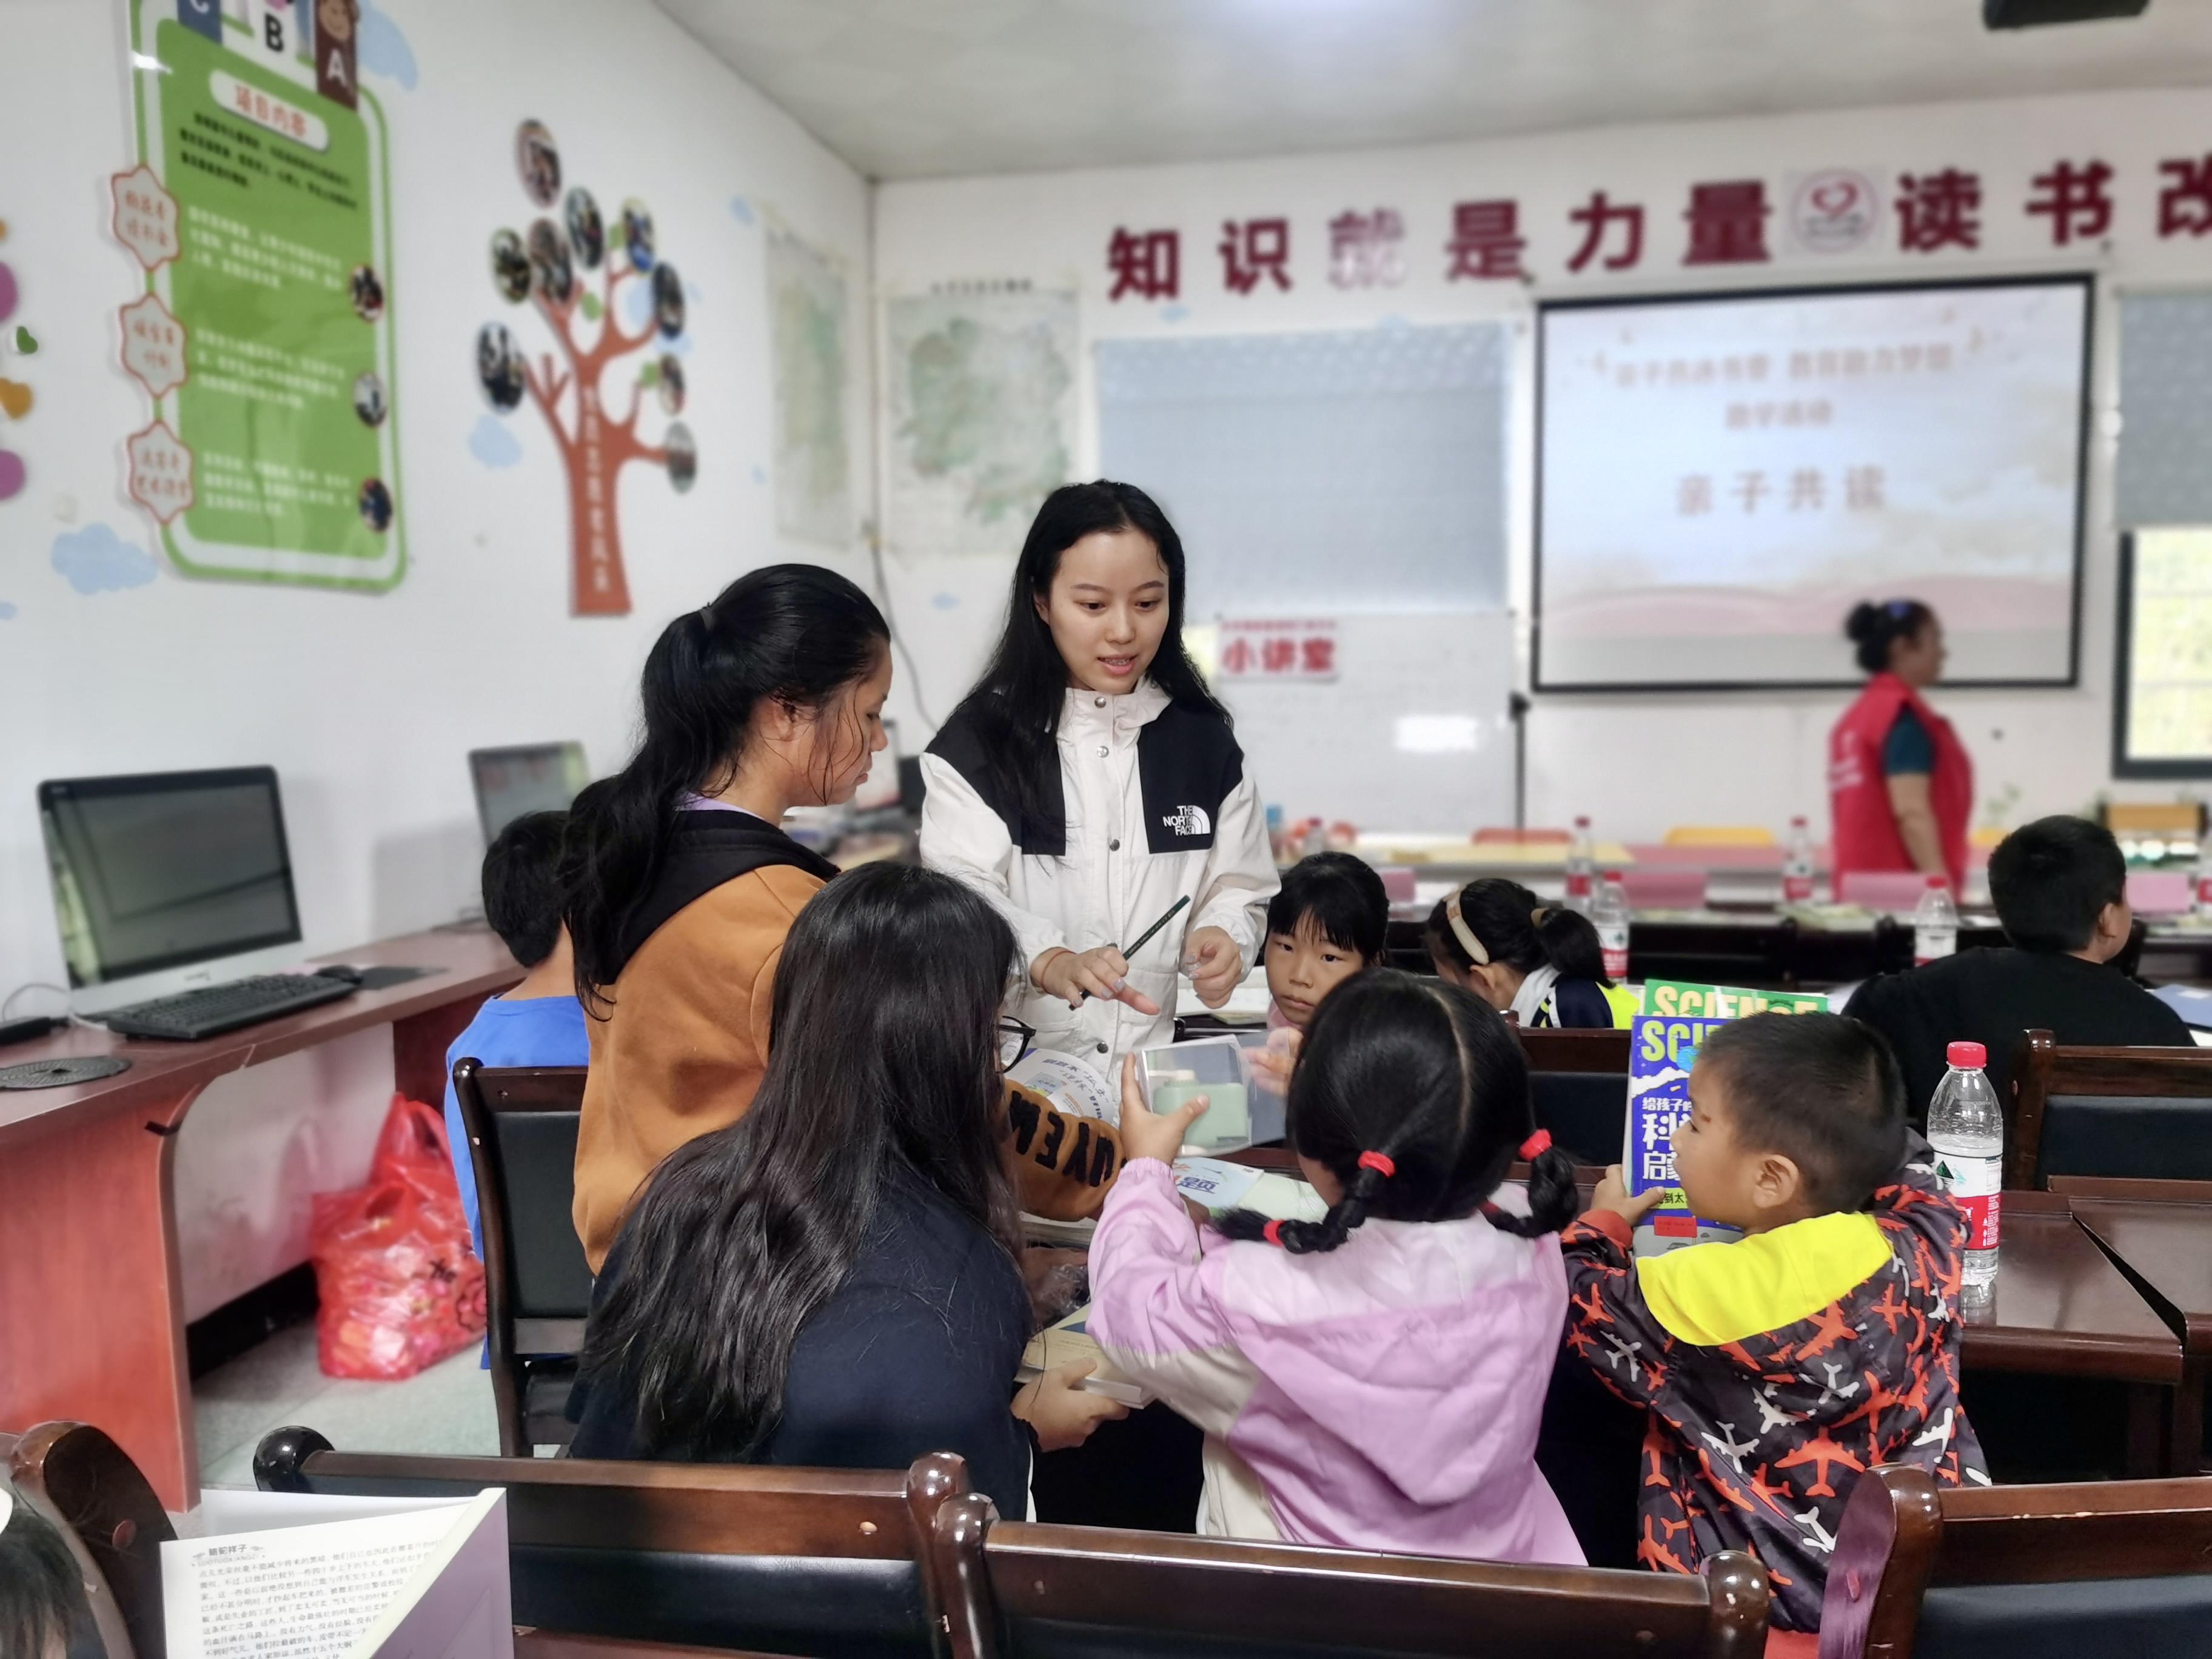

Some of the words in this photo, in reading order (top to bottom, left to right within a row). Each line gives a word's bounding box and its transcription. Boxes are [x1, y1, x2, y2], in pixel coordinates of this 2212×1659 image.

[265, 12, 284, 52] B
[327, 49, 348, 86] A
[1107, 179, 1772, 302] 知识就是力量
[1162, 816, 1193, 826] NORTH
[1177, 805, 1193, 816] THE
[1175, 825, 1192, 836] FACE
[1652, 985, 1819, 1019] SCIEN
[1641, 1021, 1721, 1062] SCI
[1641, 1113, 1691, 1151] 科
